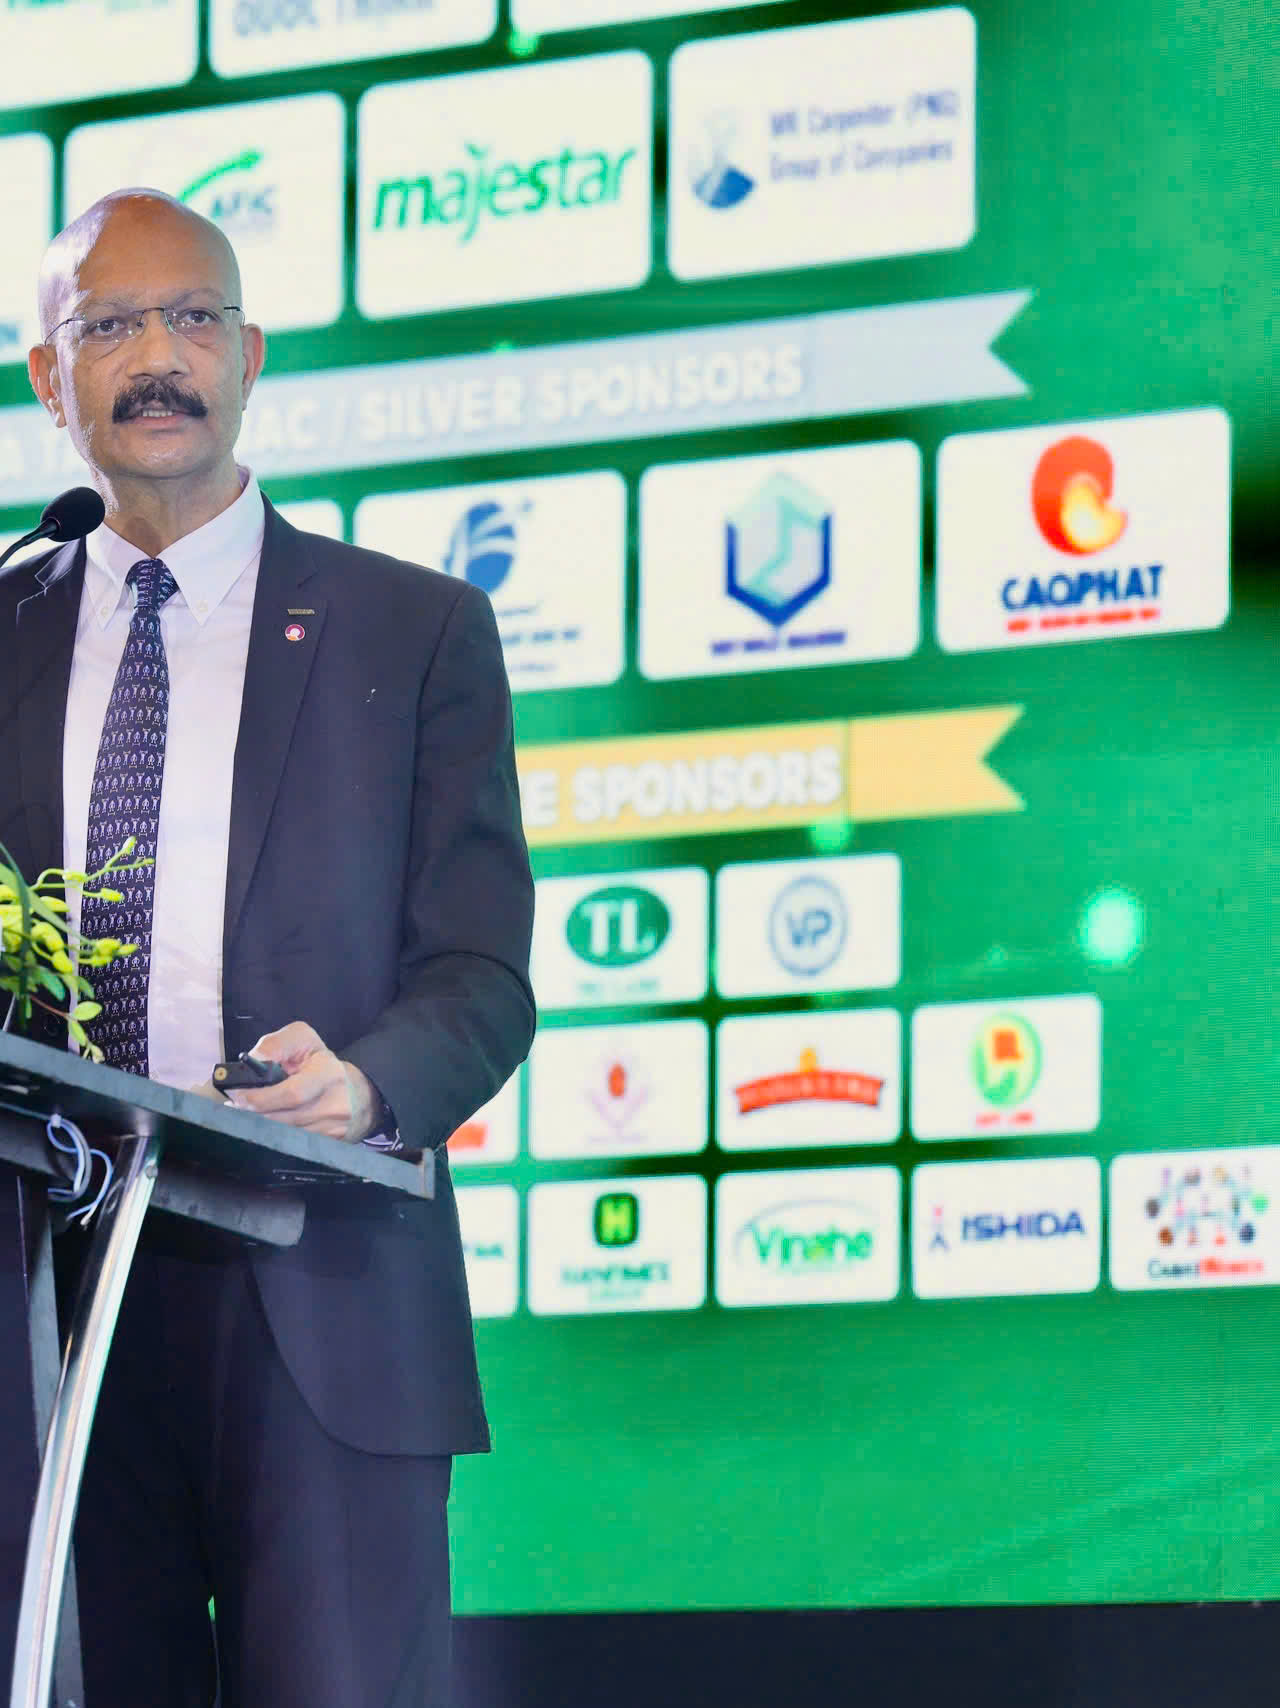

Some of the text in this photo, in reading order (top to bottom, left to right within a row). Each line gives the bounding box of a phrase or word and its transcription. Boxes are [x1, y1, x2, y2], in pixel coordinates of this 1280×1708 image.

[372, 141, 638, 247] majestar
[359, 372, 523, 442] SILVER
[539, 346, 803, 419] SPONSORS
[574, 746, 843, 824] SPONSORS
[961, 1210, 1087, 1242] ISHIDA
